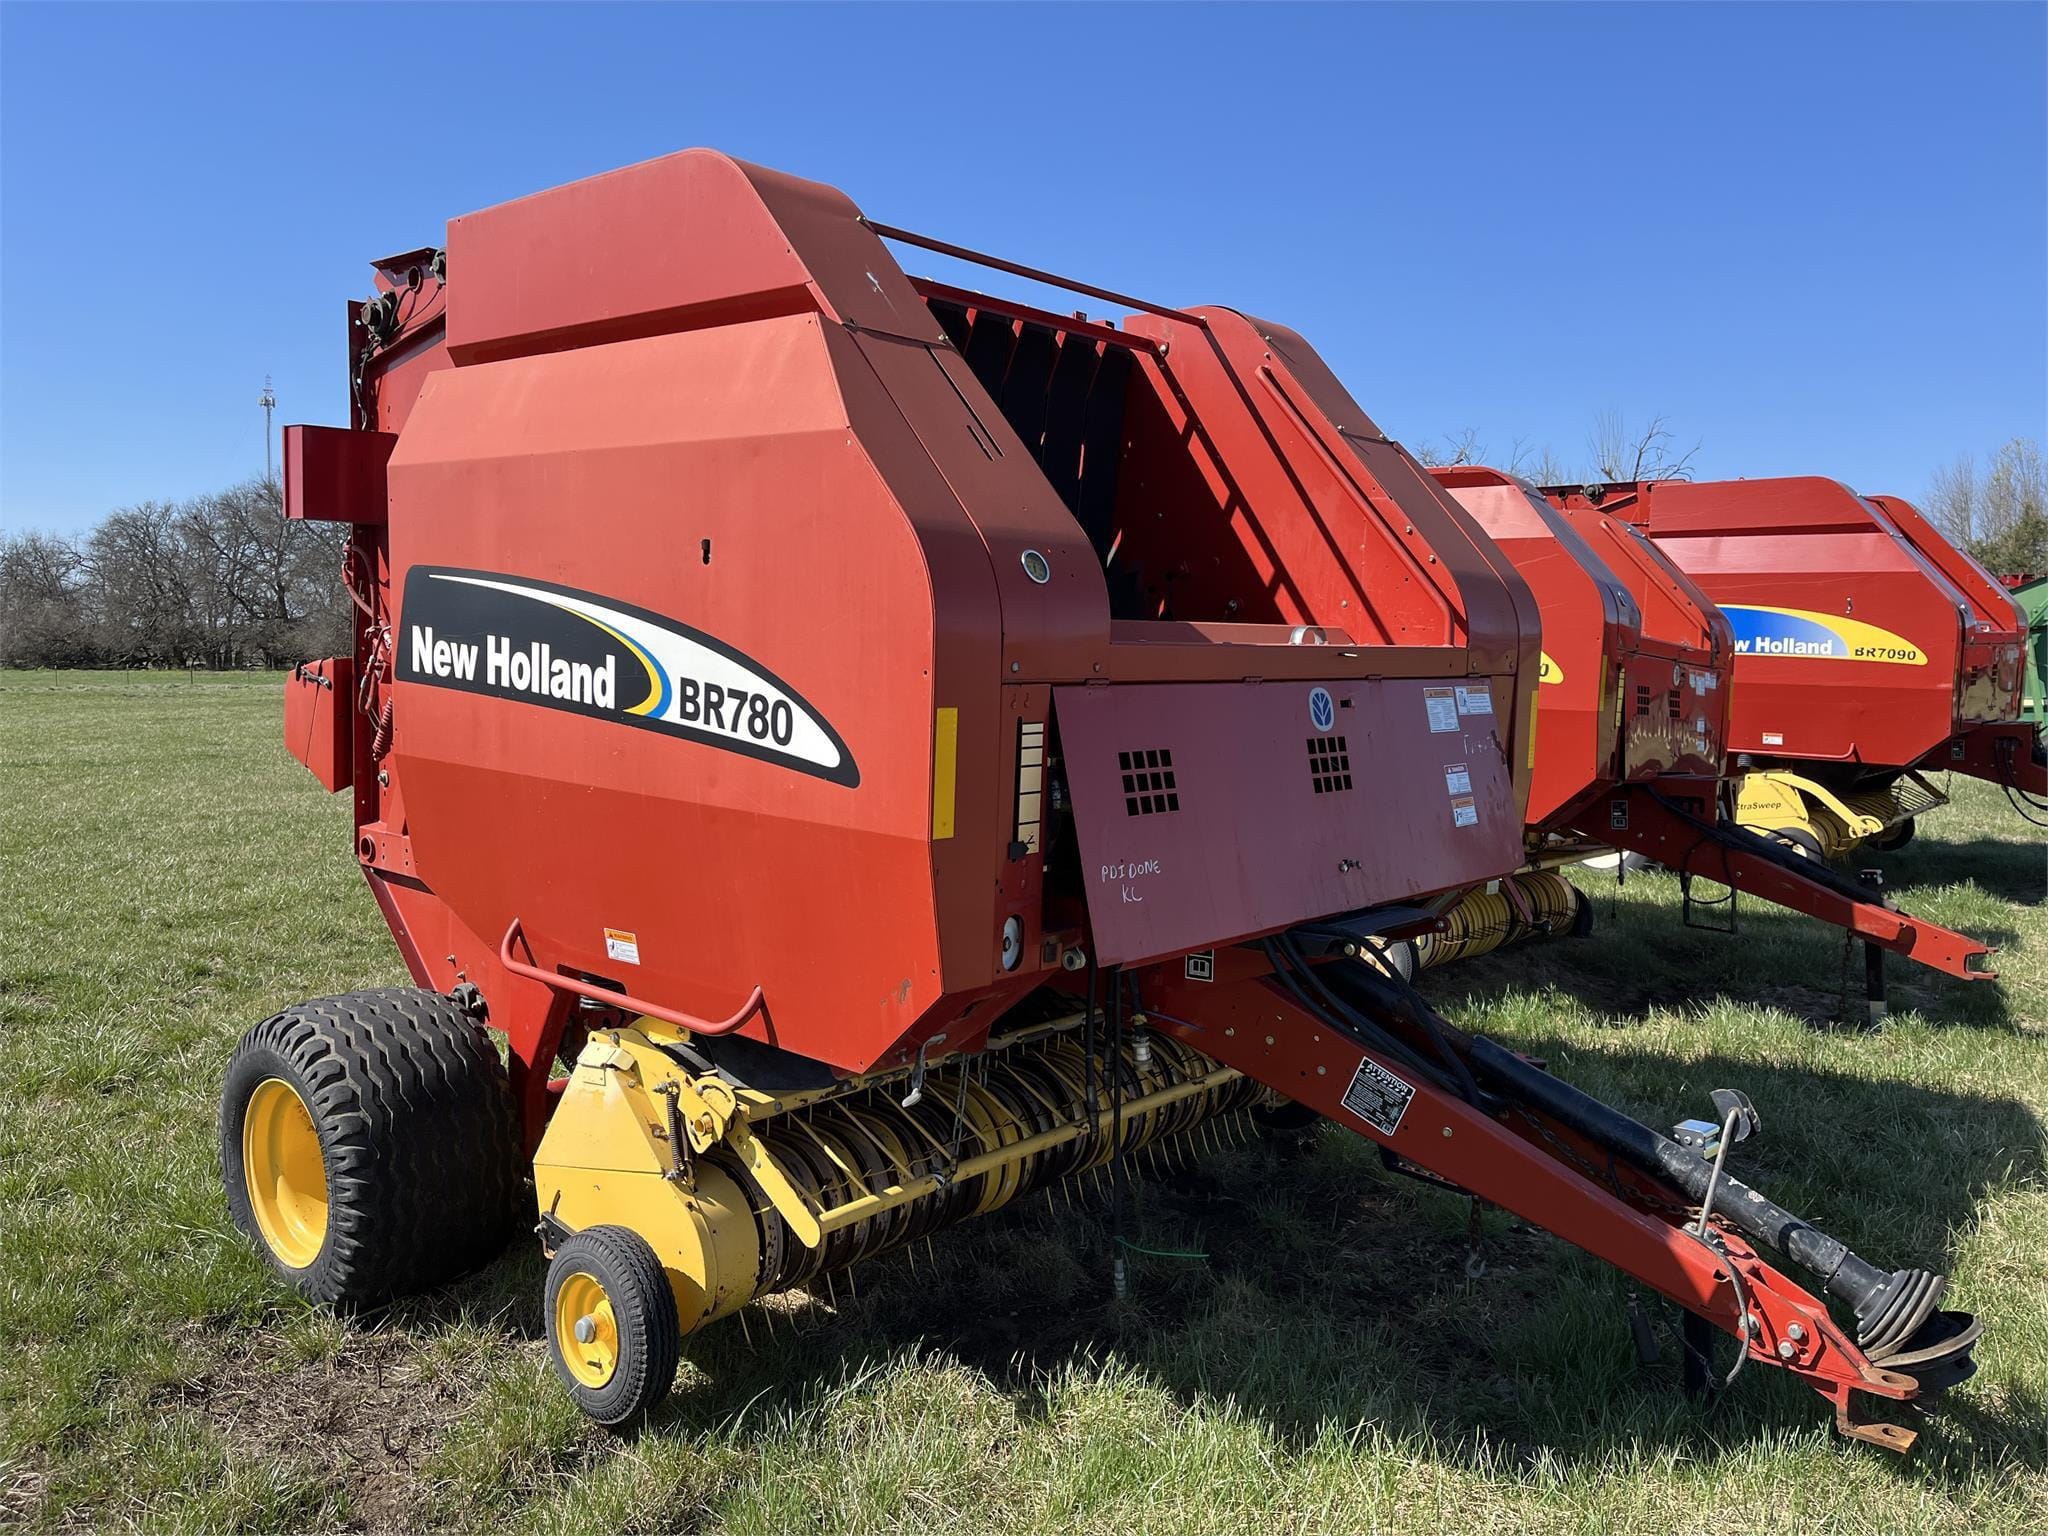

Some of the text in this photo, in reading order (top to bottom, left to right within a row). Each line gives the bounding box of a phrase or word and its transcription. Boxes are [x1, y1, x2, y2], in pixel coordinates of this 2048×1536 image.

[1755, 636, 1833, 656] Holland
[1854, 647, 1917, 661] BR7090
[411, 625, 616, 709] New Holland
[679, 676, 793, 746] BR780
[1101, 859, 1161, 883] PDI DONE
[1367, 1063, 1409, 1093] ATTENTION
